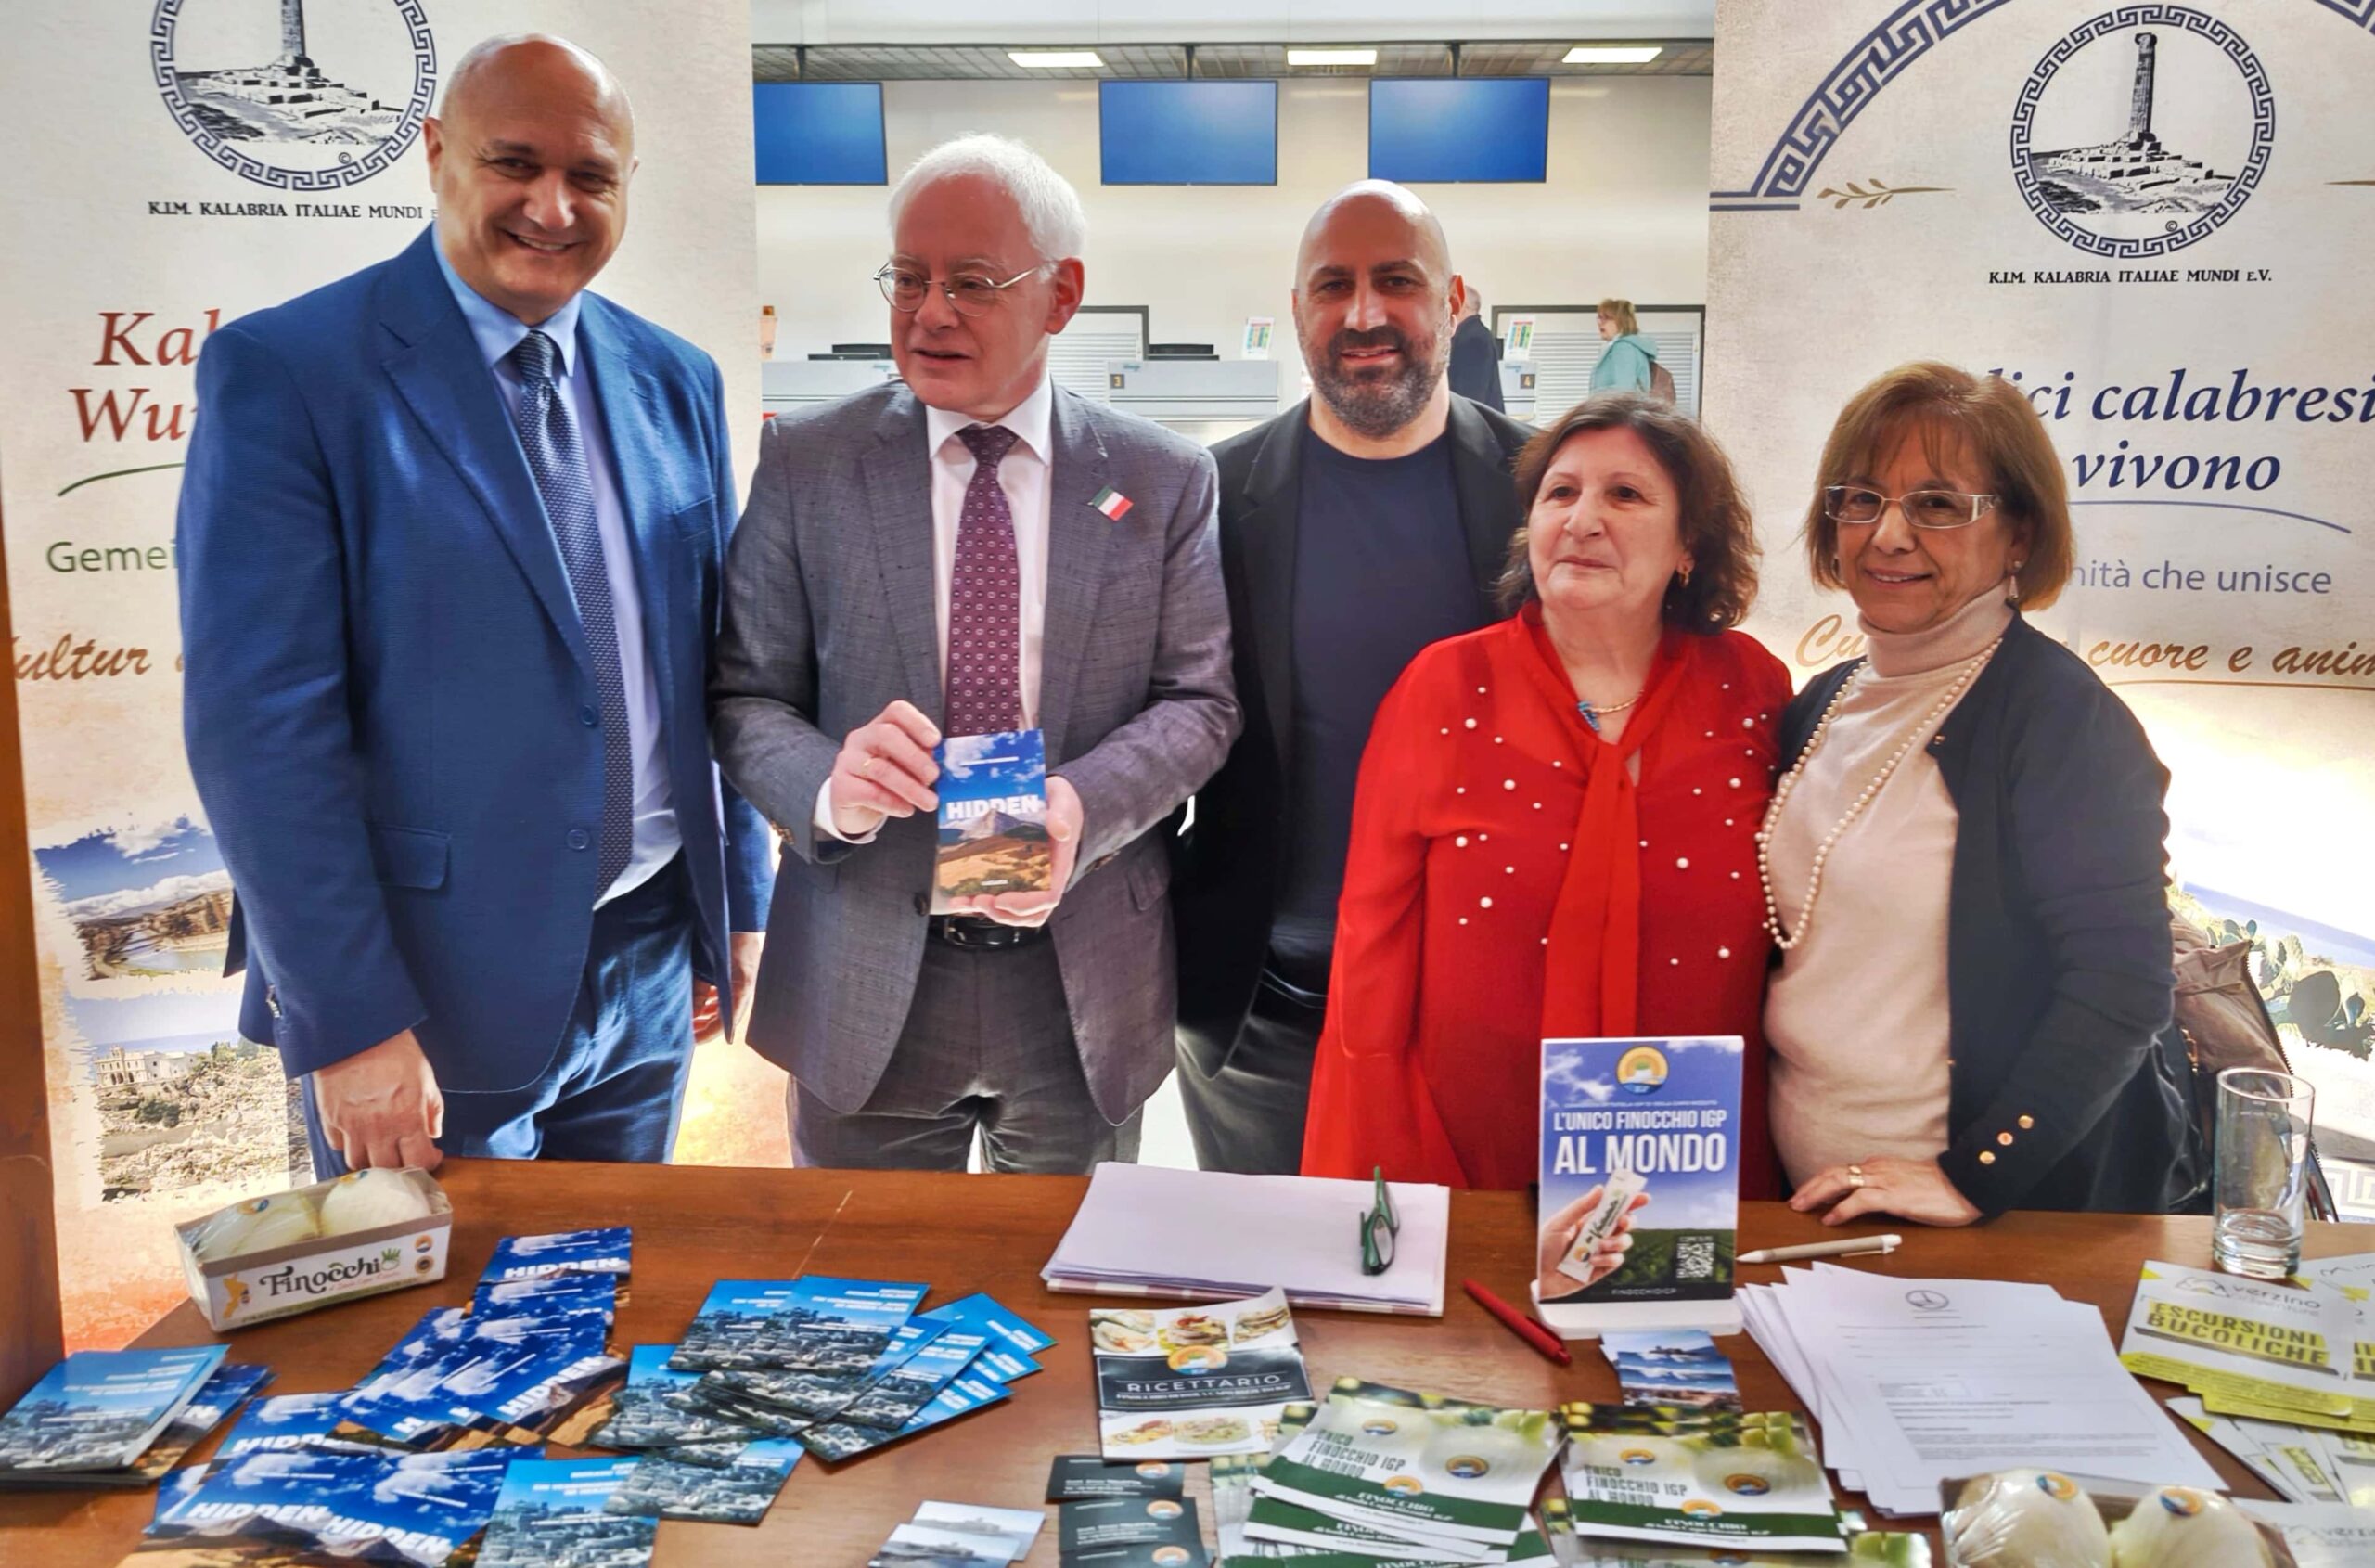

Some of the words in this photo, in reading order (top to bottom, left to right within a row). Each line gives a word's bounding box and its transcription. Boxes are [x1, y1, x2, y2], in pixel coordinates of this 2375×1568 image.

[199, 202, 288, 217] KALABRIA
[295, 203, 361, 218] ITALIAE
[368, 205, 423, 219] MUNDI
[1988, 271, 2026, 284] K.I.M.
[2033, 270, 2112, 284] KALABRIA
[2118, 270, 2179, 283] ITALIAE
[2186, 269, 2240, 282] MUNDI
[2091, 368, 2375, 423] calabresi
[68, 388, 198, 442] Wu
[2072, 440, 2281, 490] vivono
[2142, 560, 2205, 590] che
[2217, 564, 2331, 594] unisce
[12, 633, 152, 680] ultur
[1796, 614, 1865, 667] Cu
[2087, 639, 2209, 671] cuore
[2228, 646, 2253, 673] e
[945, 794, 1040, 820] HIDDEN
[1553, 1112, 1613, 1132] L'UNICO
[1616, 1110, 1698, 1130] FINOCCHIO
[1700, 1109, 1727, 1128] IGP
[1553, 1136, 1597, 1175] AL
[1605, 1132, 1727, 1174] MONDO
[504, 1257, 622, 1279] HIDDEN
[2232, 1285, 2321, 1309] verzino
[2147, 1313, 2327, 1366] BUCOLICHE
[2154, 1302, 2318, 1346] ESCURSIONI
[1126, 1374, 1281, 1393] RICETTARIO
[1308, 1440, 1380, 1467] FINOCCHIO
[1380, 1455, 1406, 1472] IGP
[1586, 1476, 1659, 1494] FINOCCHIO
[1664, 1483, 1688, 1497] IGP
[186, 1502, 329, 1522] HIDDEN
[326, 1514, 452, 1555] HIDDEN
